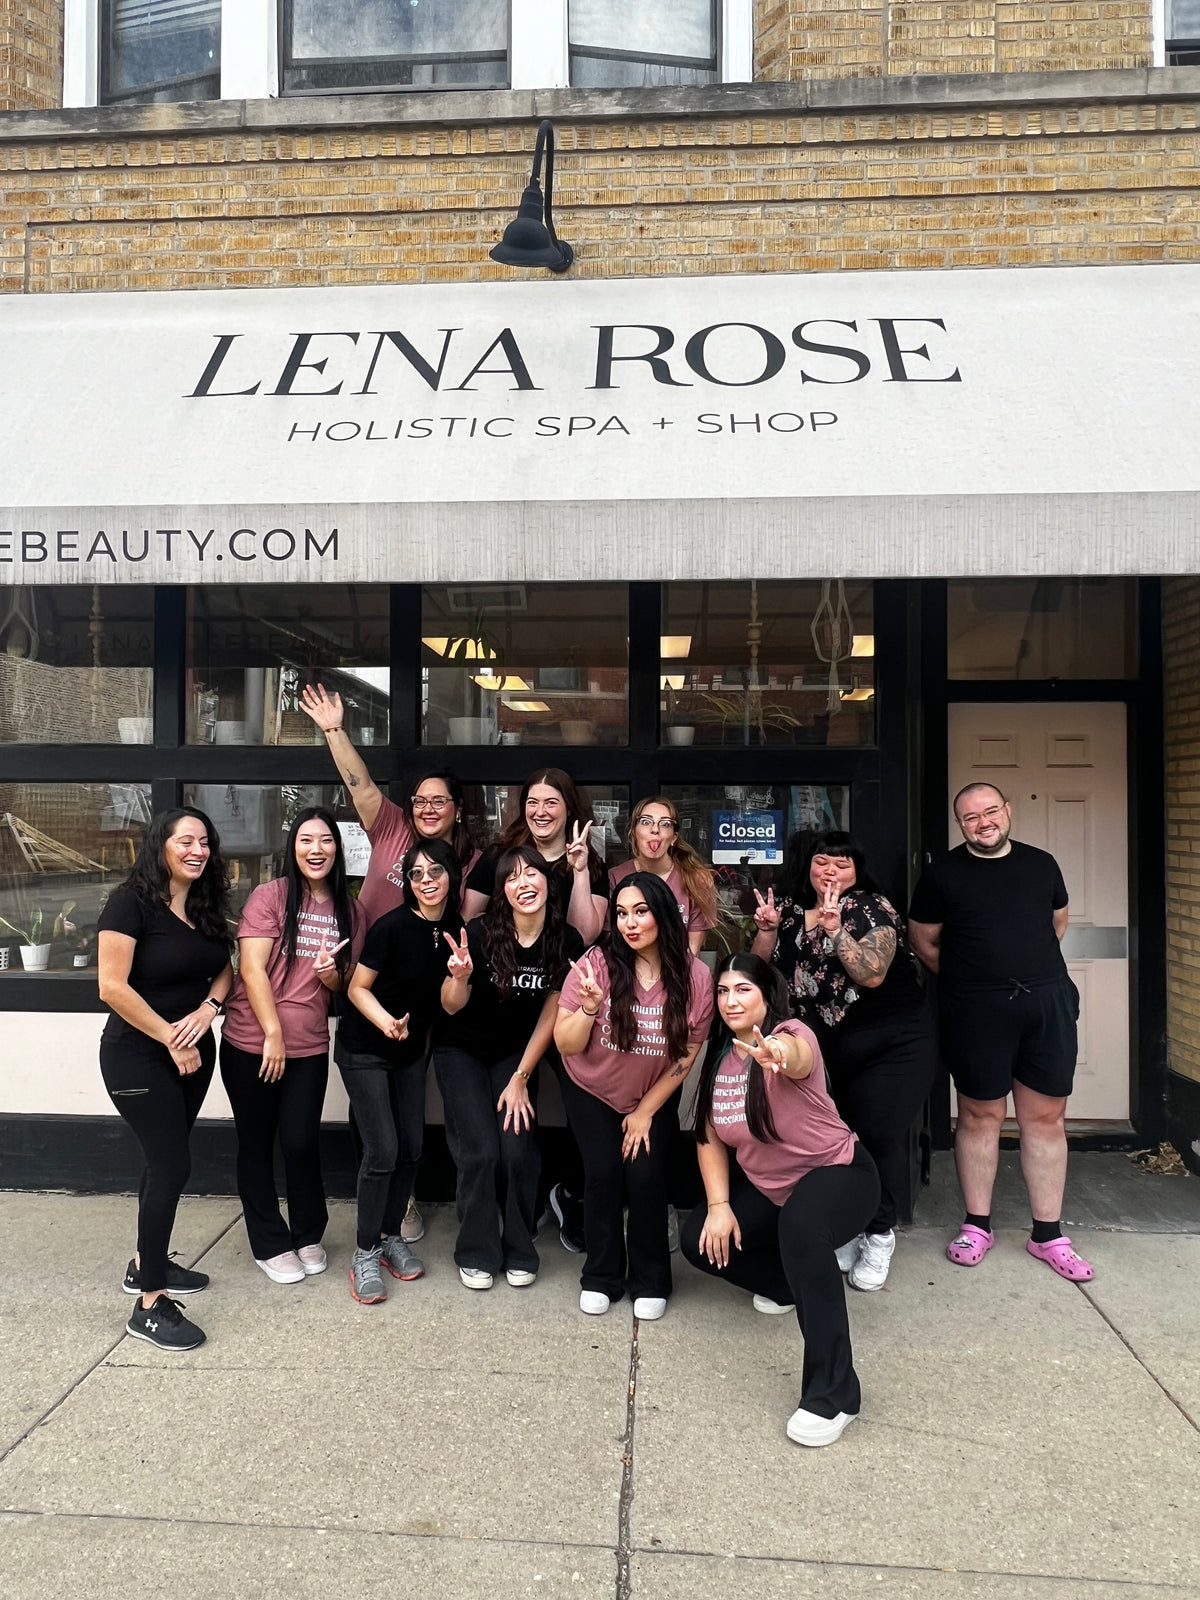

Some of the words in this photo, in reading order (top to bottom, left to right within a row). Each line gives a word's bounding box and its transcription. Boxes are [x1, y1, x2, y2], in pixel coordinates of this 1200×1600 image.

[182, 328, 545, 397] LENA
[585, 319, 962, 389] ROSE
[288, 418, 514, 442] HOLISTIC
[536, 416, 631, 437] SPA
[698, 412, 839, 434] SHOP
[0, 529, 338, 563] EBEAUTY.COM
[719, 823, 776, 838] Closed
